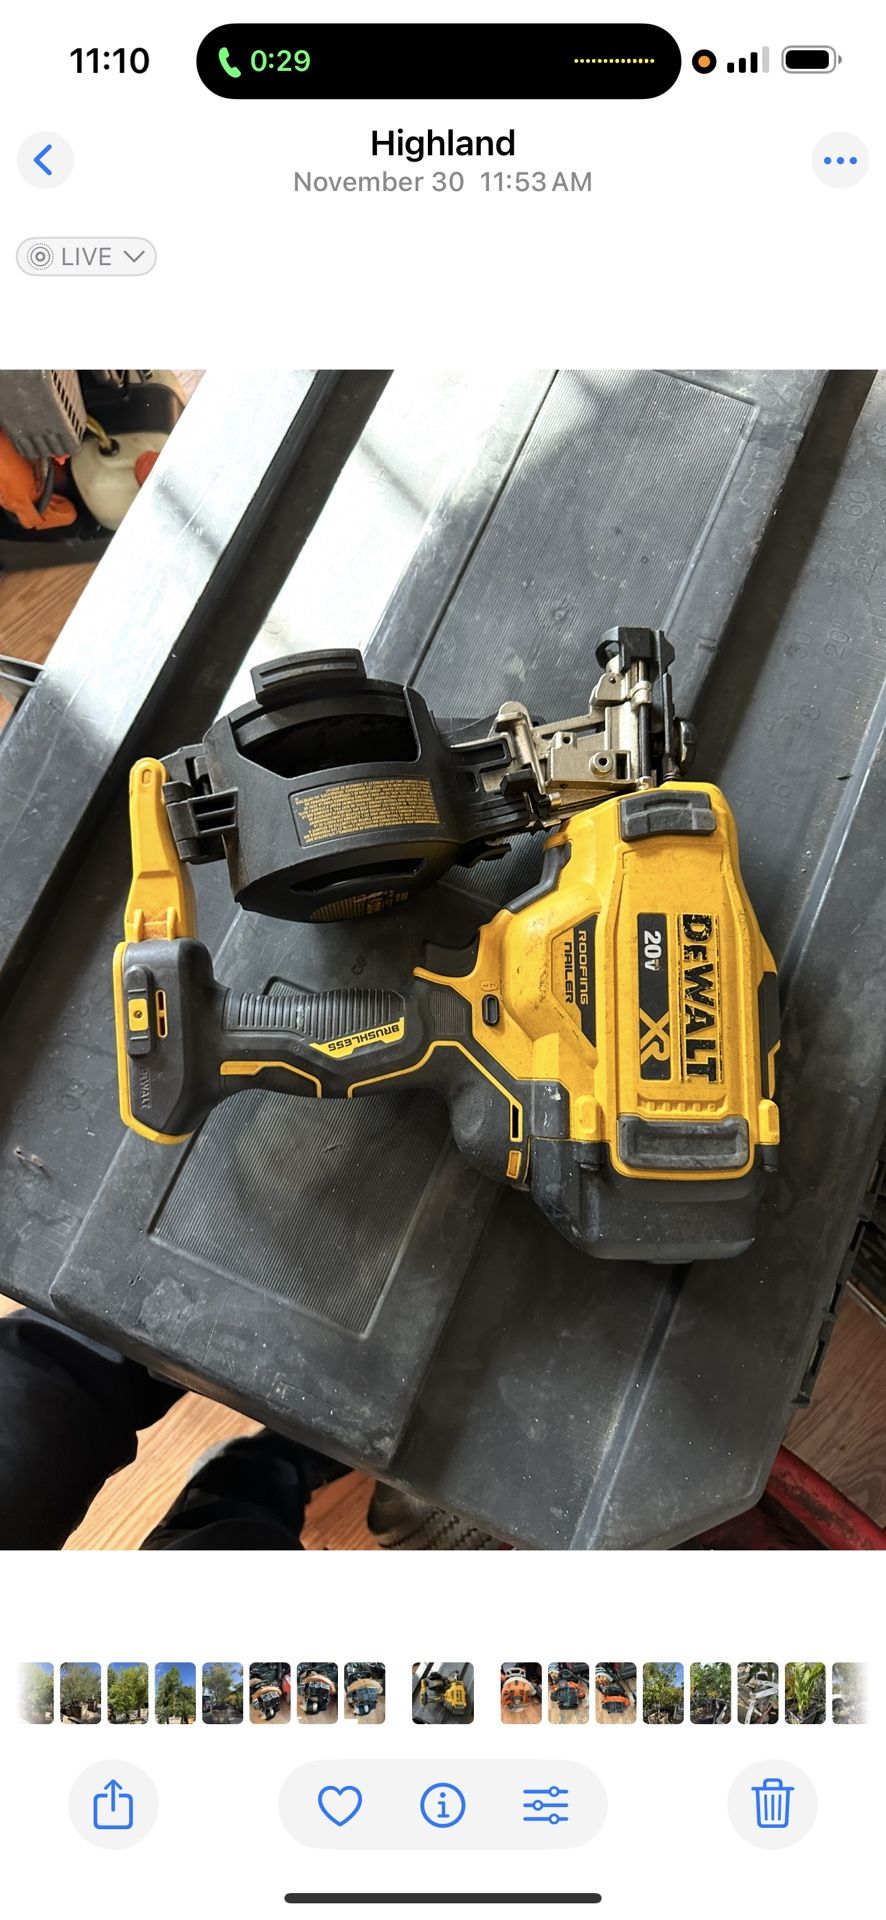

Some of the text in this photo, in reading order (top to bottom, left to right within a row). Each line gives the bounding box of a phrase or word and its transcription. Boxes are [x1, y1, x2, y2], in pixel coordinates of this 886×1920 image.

[69, 47, 150, 75] 11:10
[250, 49, 311, 73] 0:29
[371, 128, 516, 162] Highland
[294, 171, 592, 192] November 30 11:53 AM
[62, 247, 112, 266] LIVE
[563, 941, 574, 1004] NAILER
[577, 930, 590, 1006] ROOFING
[682, 913, 718, 1083] DEWALT
[327, 1024, 400, 1052] BRUSHLESS
[640, 1007, 670, 1067] XR
